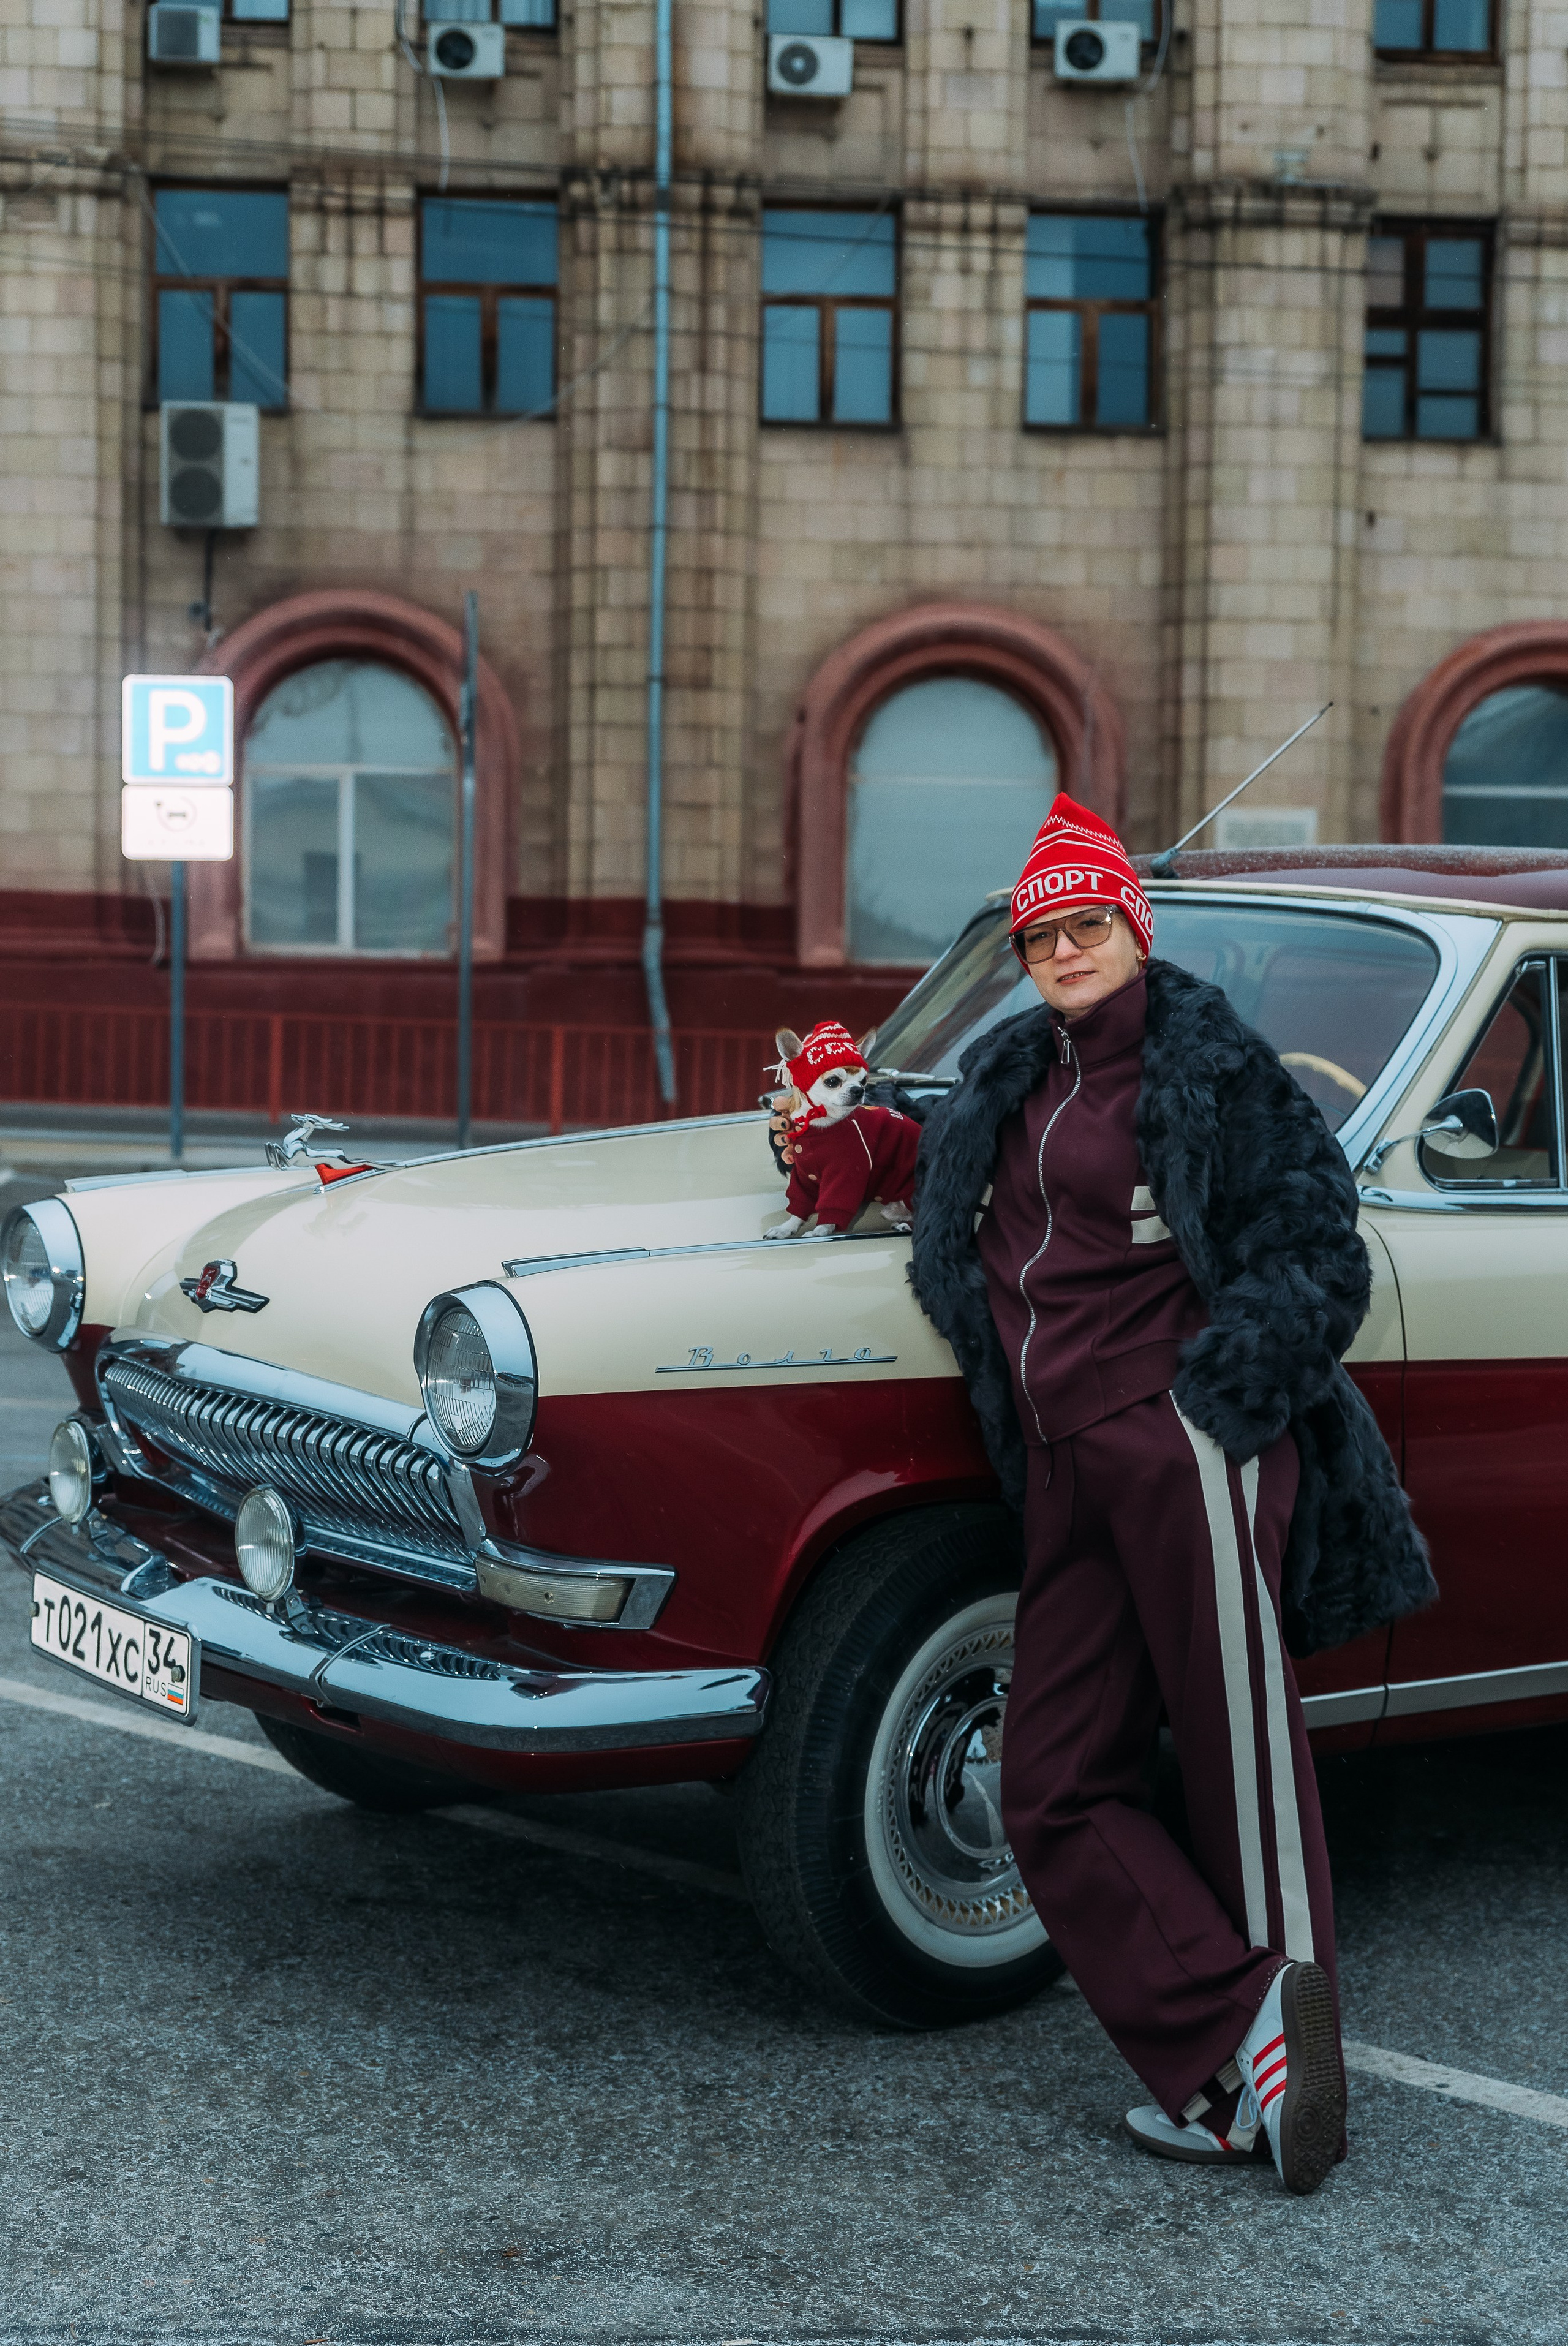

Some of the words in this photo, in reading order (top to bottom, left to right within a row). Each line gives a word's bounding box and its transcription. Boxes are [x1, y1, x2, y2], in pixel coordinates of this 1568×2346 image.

[149, 690, 207, 771] P
[1016, 870, 1103, 912] СПОРТ
[688, 1345, 873, 1367] Волга
[44, 1595, 140, 1683] Т021ХС
[148, 1629, 180, 1675] 34
[145, 1676, 167, 1698] RUS
